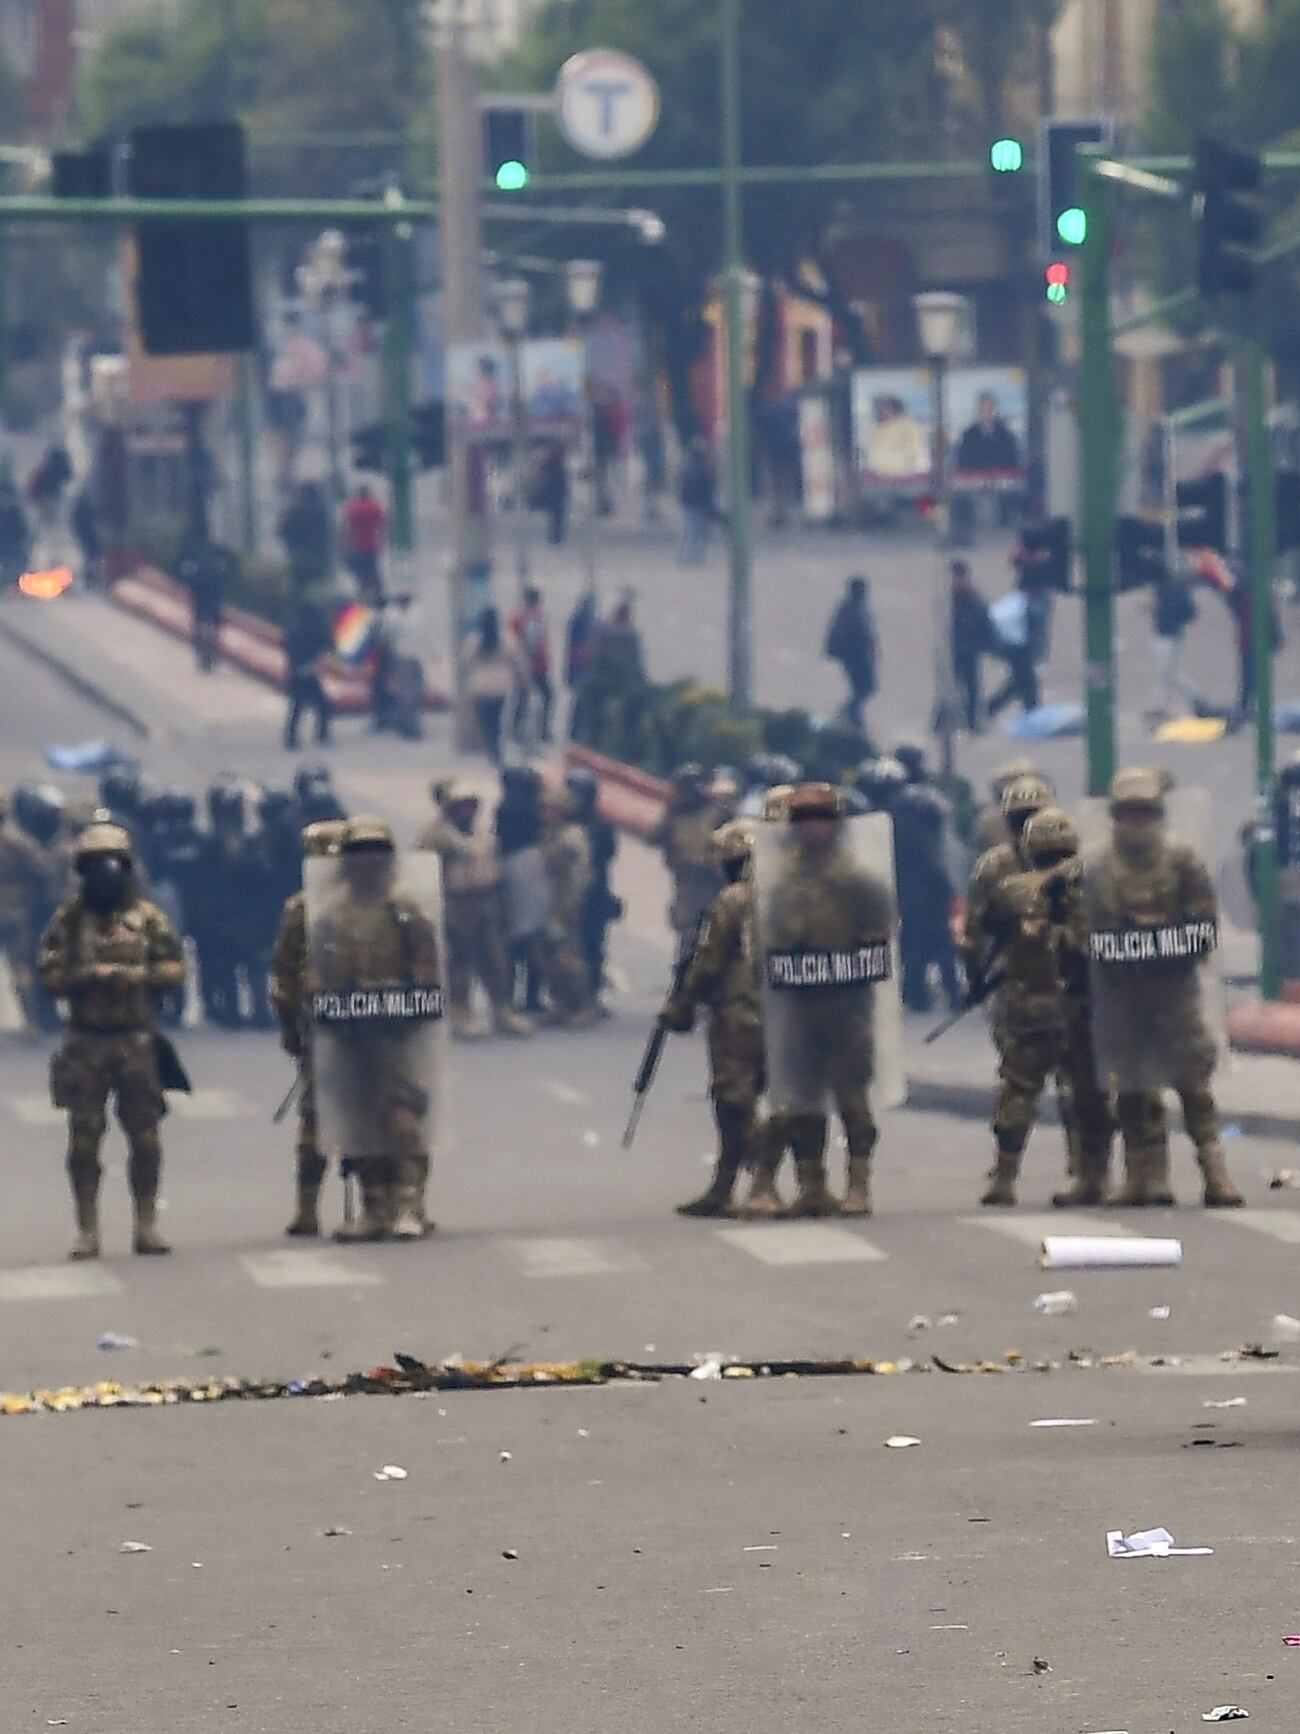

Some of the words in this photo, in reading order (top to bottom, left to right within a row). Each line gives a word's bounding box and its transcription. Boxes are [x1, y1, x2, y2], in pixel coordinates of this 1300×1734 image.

[583, 82, 631, 137] T
[1089, 931, 1156, 959] POLICIA
[313, 990, 380, 1017] POLICIA
